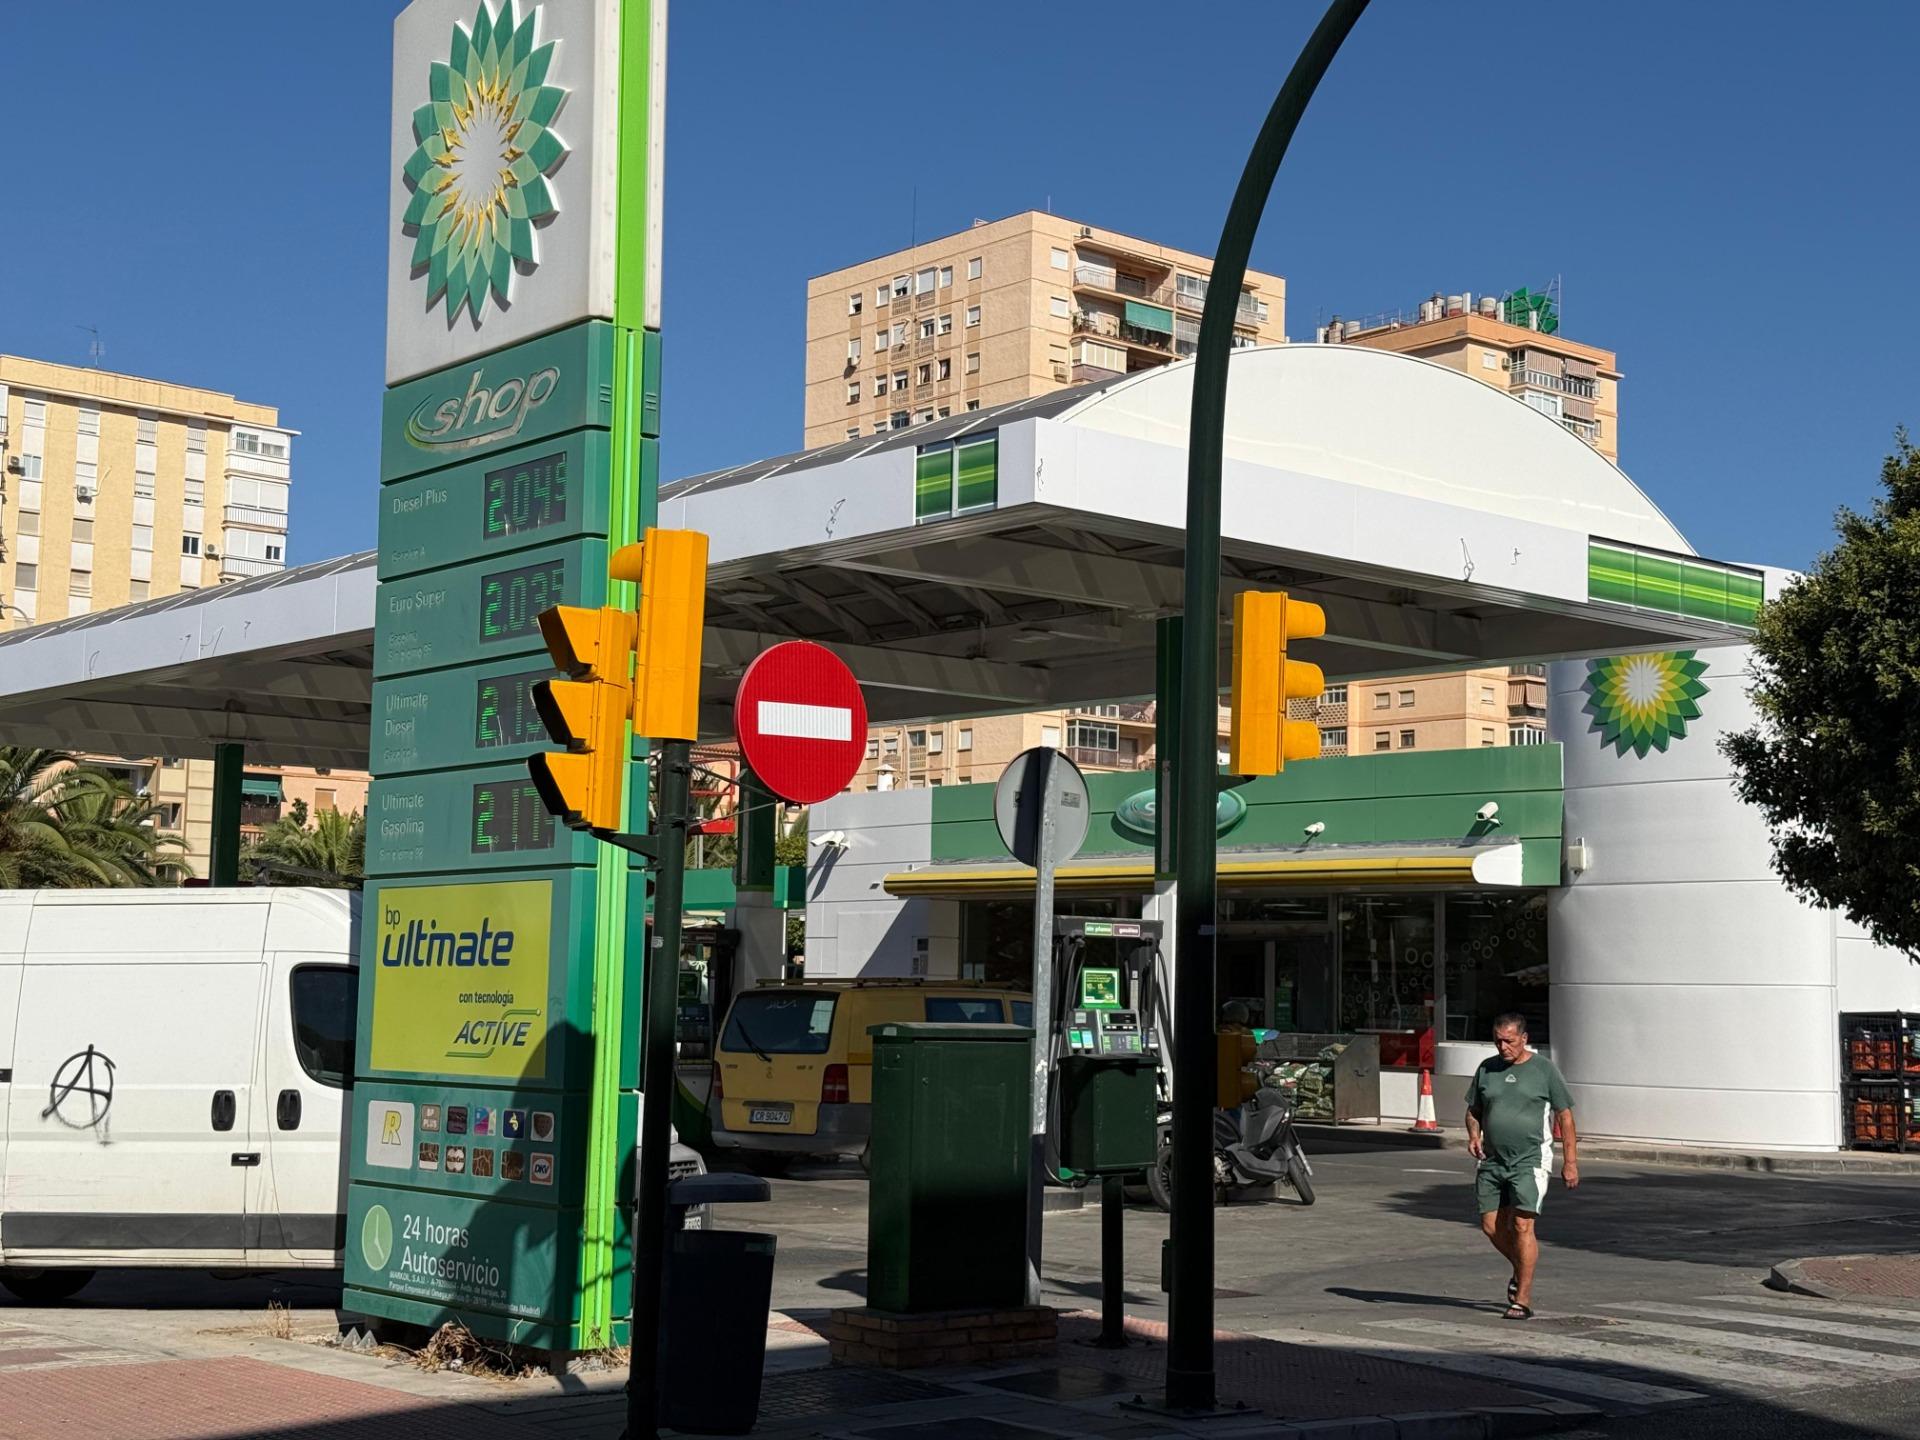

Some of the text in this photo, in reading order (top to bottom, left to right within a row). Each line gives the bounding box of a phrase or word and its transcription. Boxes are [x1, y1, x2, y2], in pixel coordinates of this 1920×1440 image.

[430, 366, 560, 438] shop
[393, 489, 448, 514] Diesel Plus
[390, 590, 447, 613] Euro Super
[386, 692, 429, 711] Ultimate
[385, 717, 415, 736] Diesel
[382, 793, 424, 811] Ultimate
[381, 818, 424, 835] Gasolina
[386, 904, 401, 930] bp
[383, 917, 514, 967] ultimate
[459, 993, 473, 1003] con
[453, 1021, 532, 1046] ACTIVE
[381, 1110, 402, 1145] R
[534, 1164, 549, 1175] DKV
[402, 1214, 469, 1248] 24 horas
[400, 1245, 499, 1287] Autoservicio
